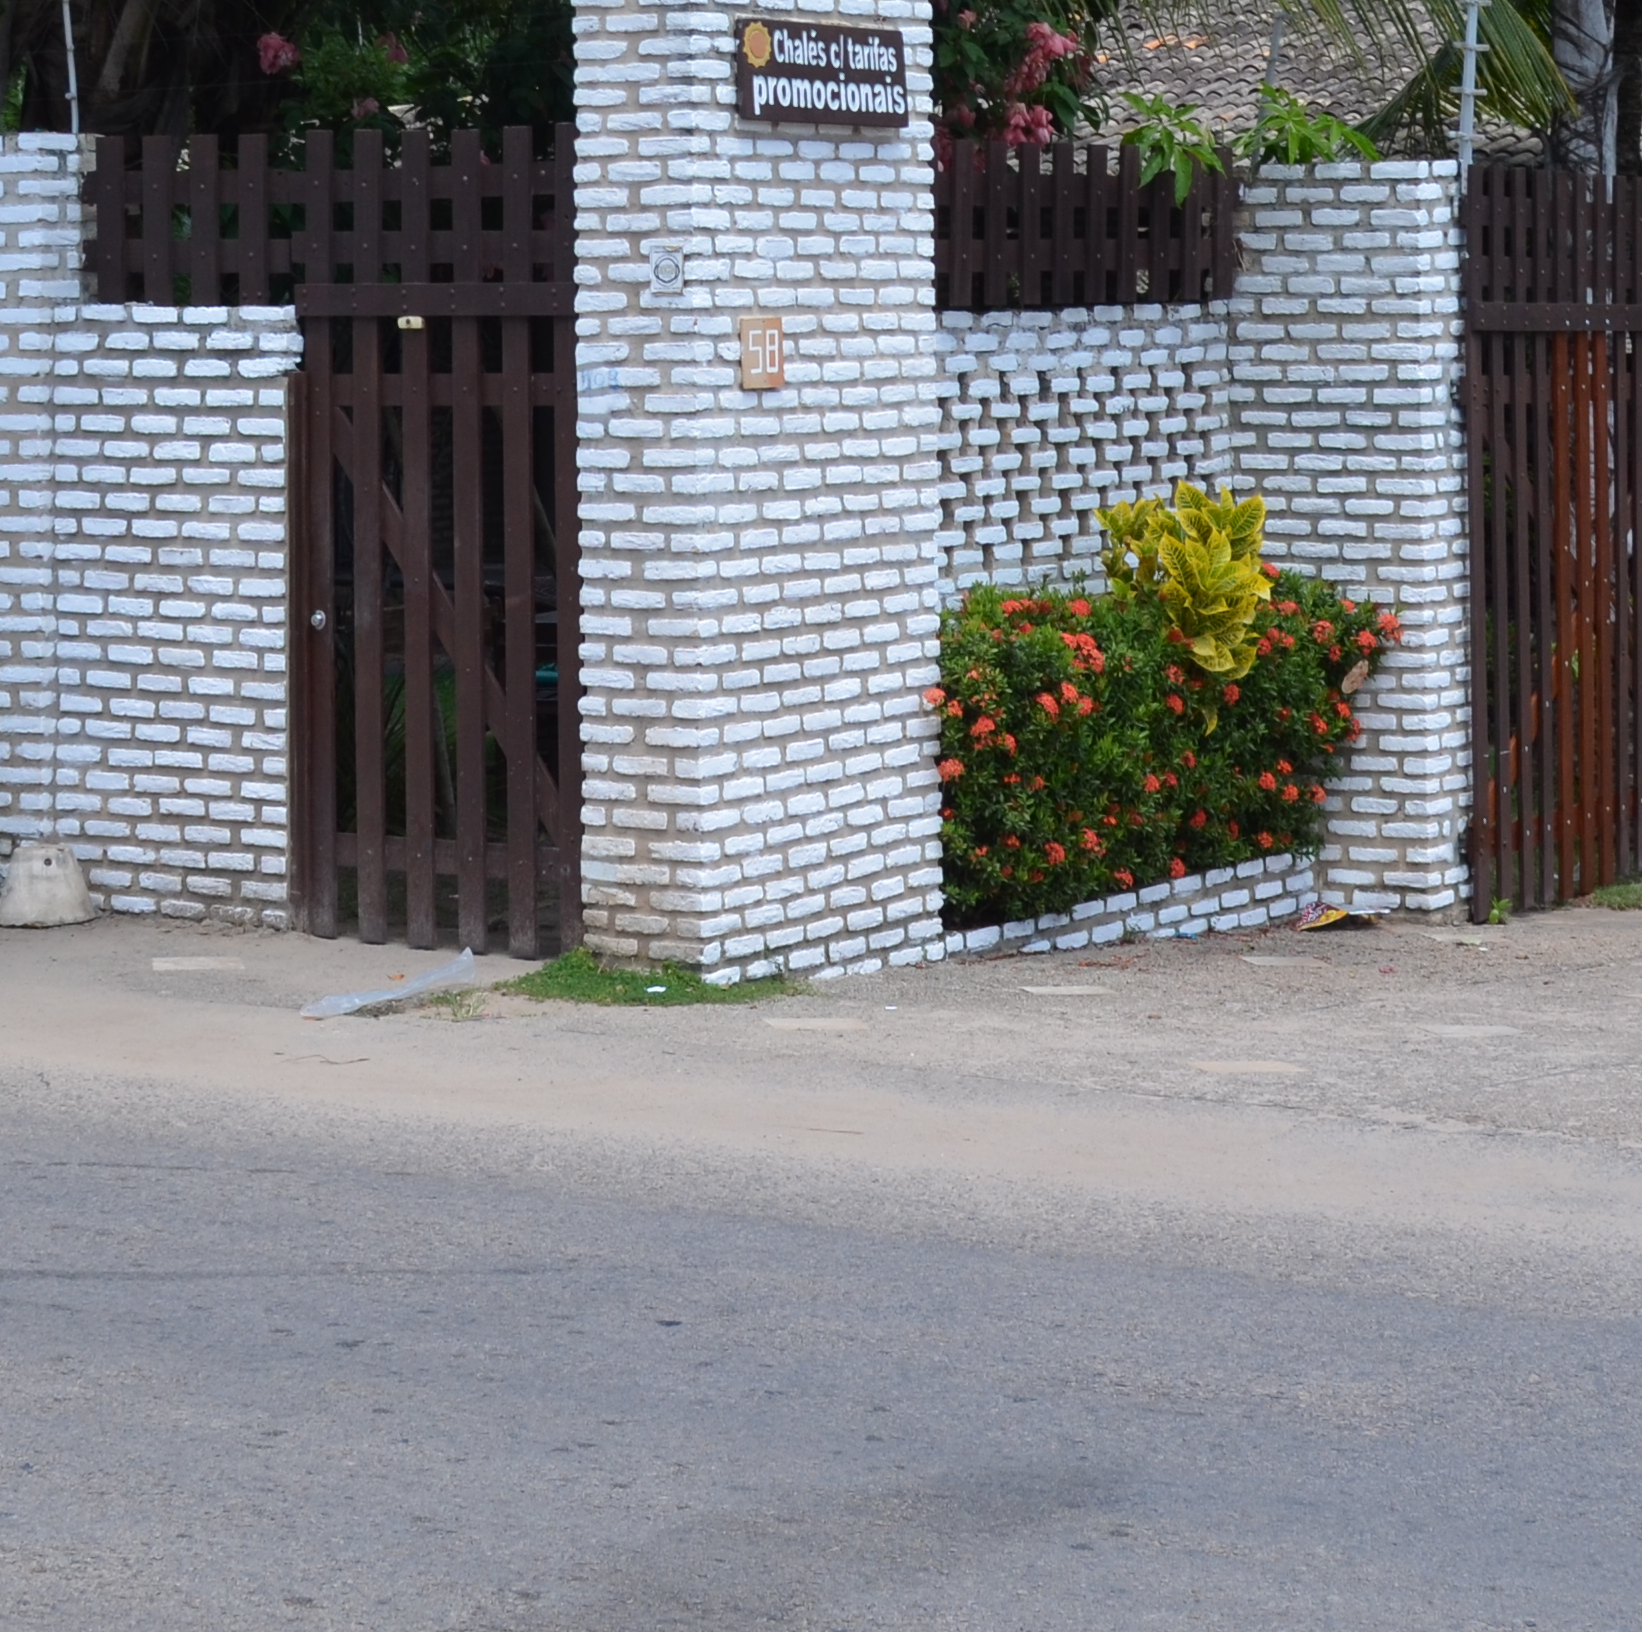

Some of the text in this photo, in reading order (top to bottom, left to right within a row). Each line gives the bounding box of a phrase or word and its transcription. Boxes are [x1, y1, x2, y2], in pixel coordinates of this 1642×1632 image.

[773, 28, 827, 67] Chalés
[847, 35, 898, 72] tarifas
[752, 72, 905, 116] promocionais
[748, 329, 779, 374] 58
